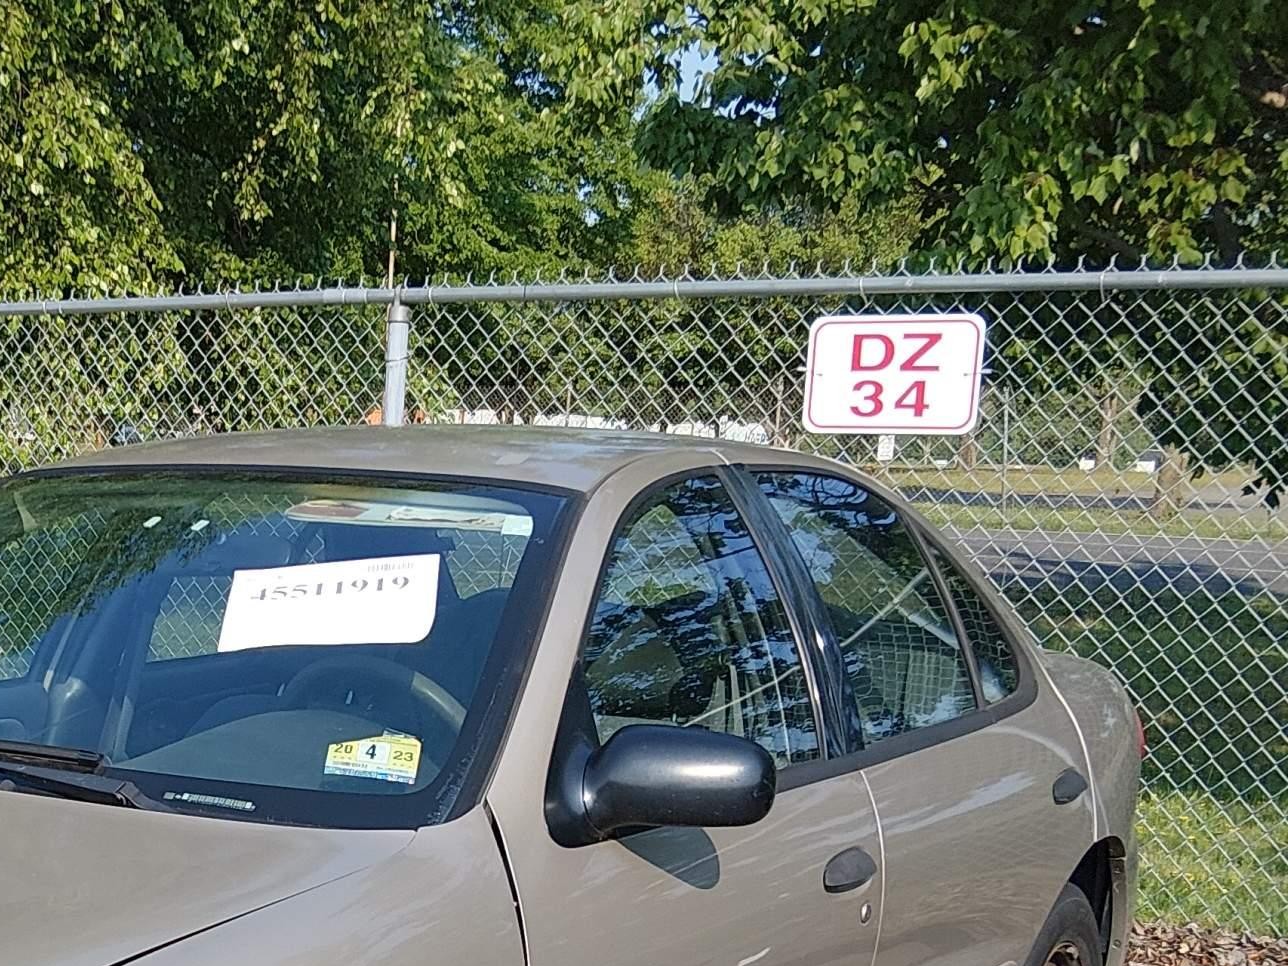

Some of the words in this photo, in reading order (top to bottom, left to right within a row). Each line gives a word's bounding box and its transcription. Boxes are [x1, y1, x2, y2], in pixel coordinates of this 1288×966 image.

[850, 332, 943, 373] DZ
[850, 379, 929, 418] 34
[250, 575, 411, 601] 45511919
[333, 743, 354, 754] 20
[365, 743, 377, 760] 4
[392, 750, 414, 762] 23
